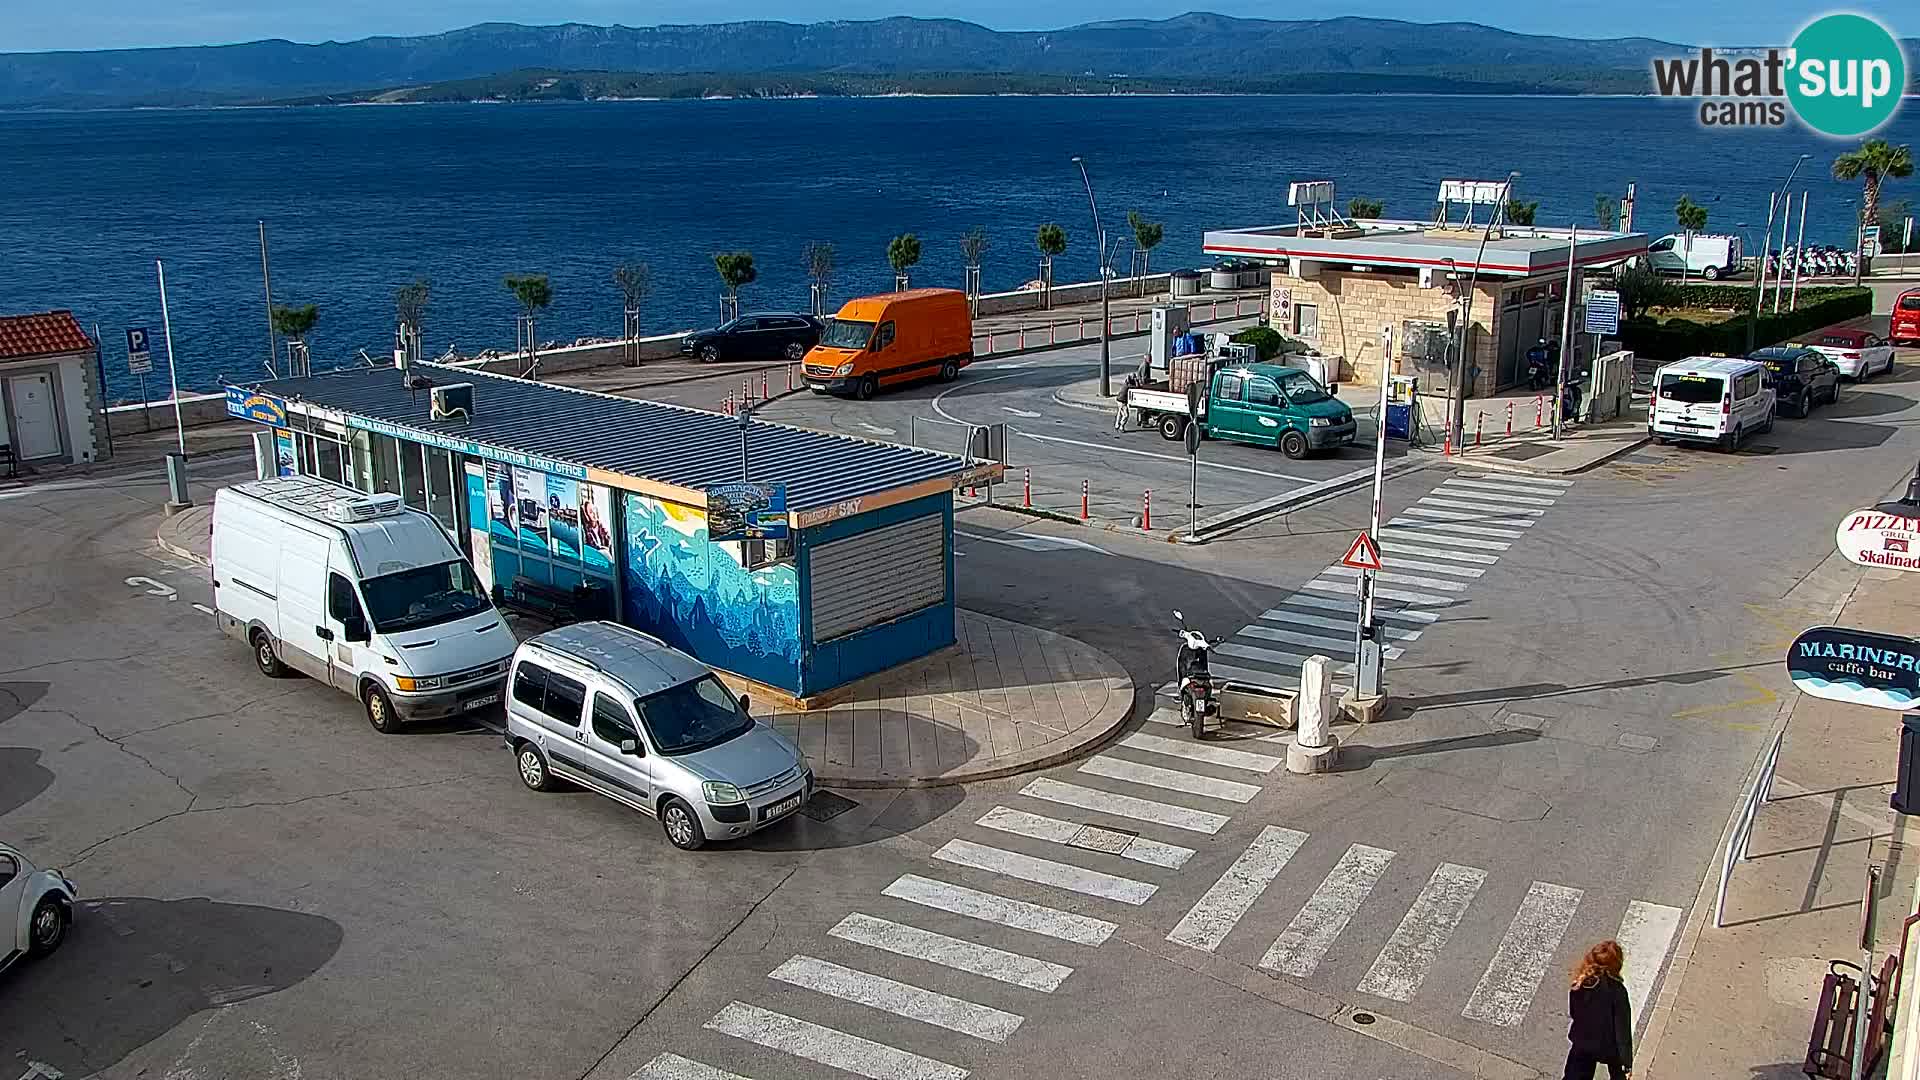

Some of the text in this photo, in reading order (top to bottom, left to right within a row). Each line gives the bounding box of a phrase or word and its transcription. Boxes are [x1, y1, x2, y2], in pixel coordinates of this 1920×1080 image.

[131, 331, 143, 349] P
[437, 436, 469, 452] POSTAJA
[479, 447, 494, 458] BUS
[494, 448, 528, 465] STATION
[528, 456, 555, 471] TICKET
[555, 461, 583, 477] OFFICE
[1848, 515, 1920, 533] PIZZE
[1880, 530, 1917, 541] GRILL
[1828, 661, 1896, 680] caffe bar
